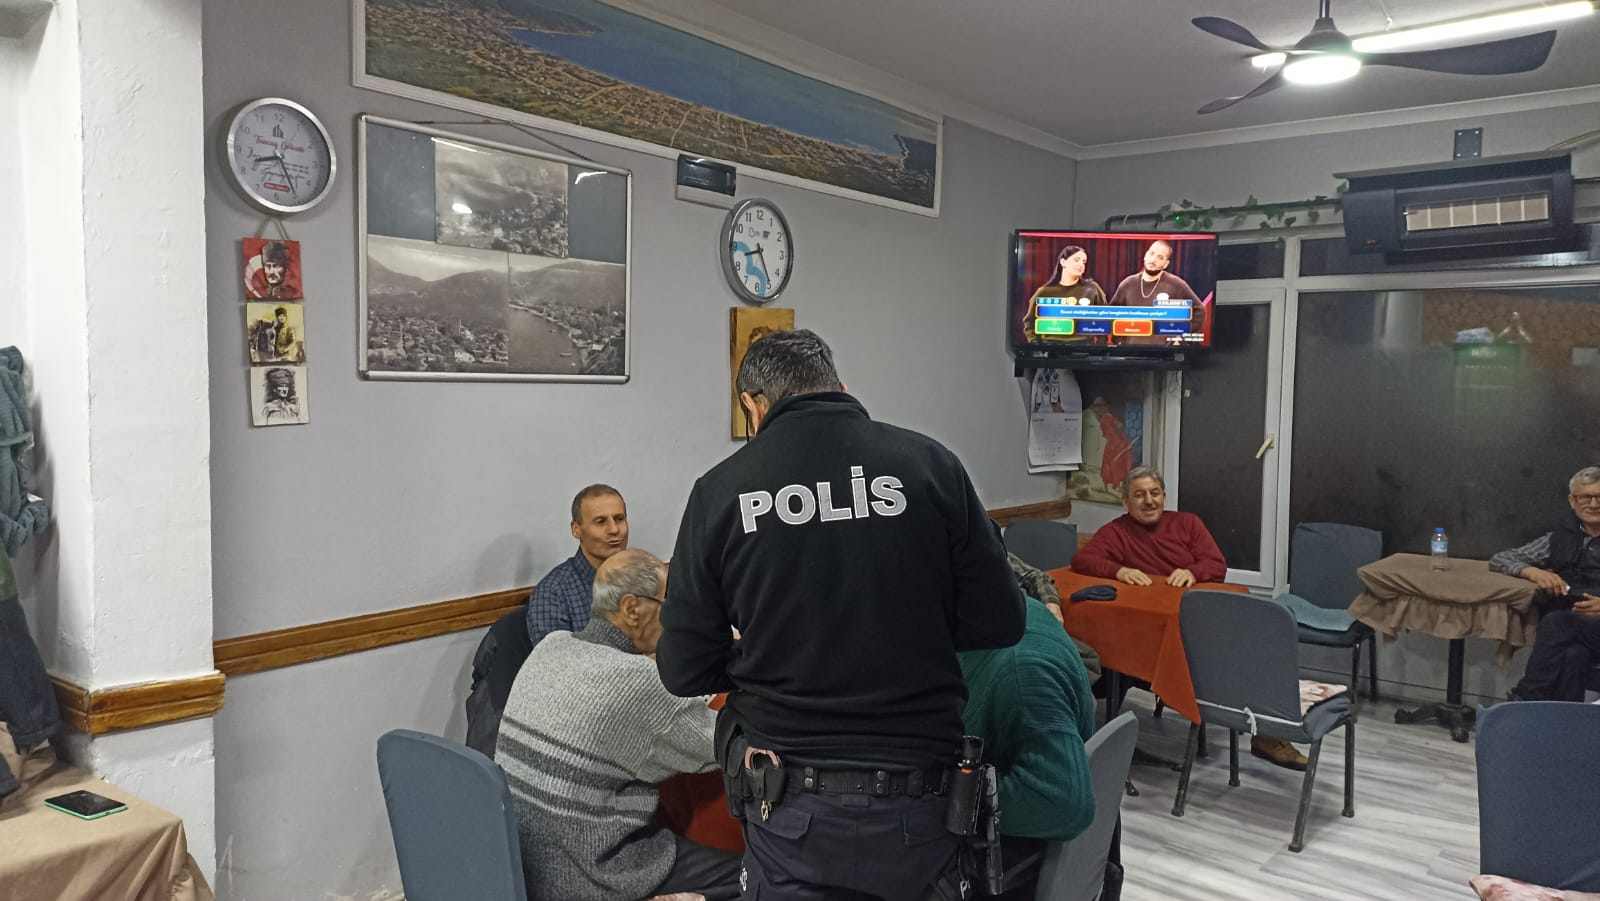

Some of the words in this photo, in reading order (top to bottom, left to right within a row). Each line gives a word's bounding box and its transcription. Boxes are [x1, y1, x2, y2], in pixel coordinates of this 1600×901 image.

[274, 113, 286, 122] 12
[745, 212, 752, 222] 11
[756, 210, 765, 221] 12
[735, 224, 744, 234] 10
[777, 232, 783, 242] 2
[779, 251, 785, 260] 3
[735, 261, 741, 271] 8
[774, 268, 780, 277] 4
[743, 275, 749, 285] 7
[766, 280, 772, 290] 5
[754, 282, 760, 292] 6
[738, 465, 908, 534] POLİS
